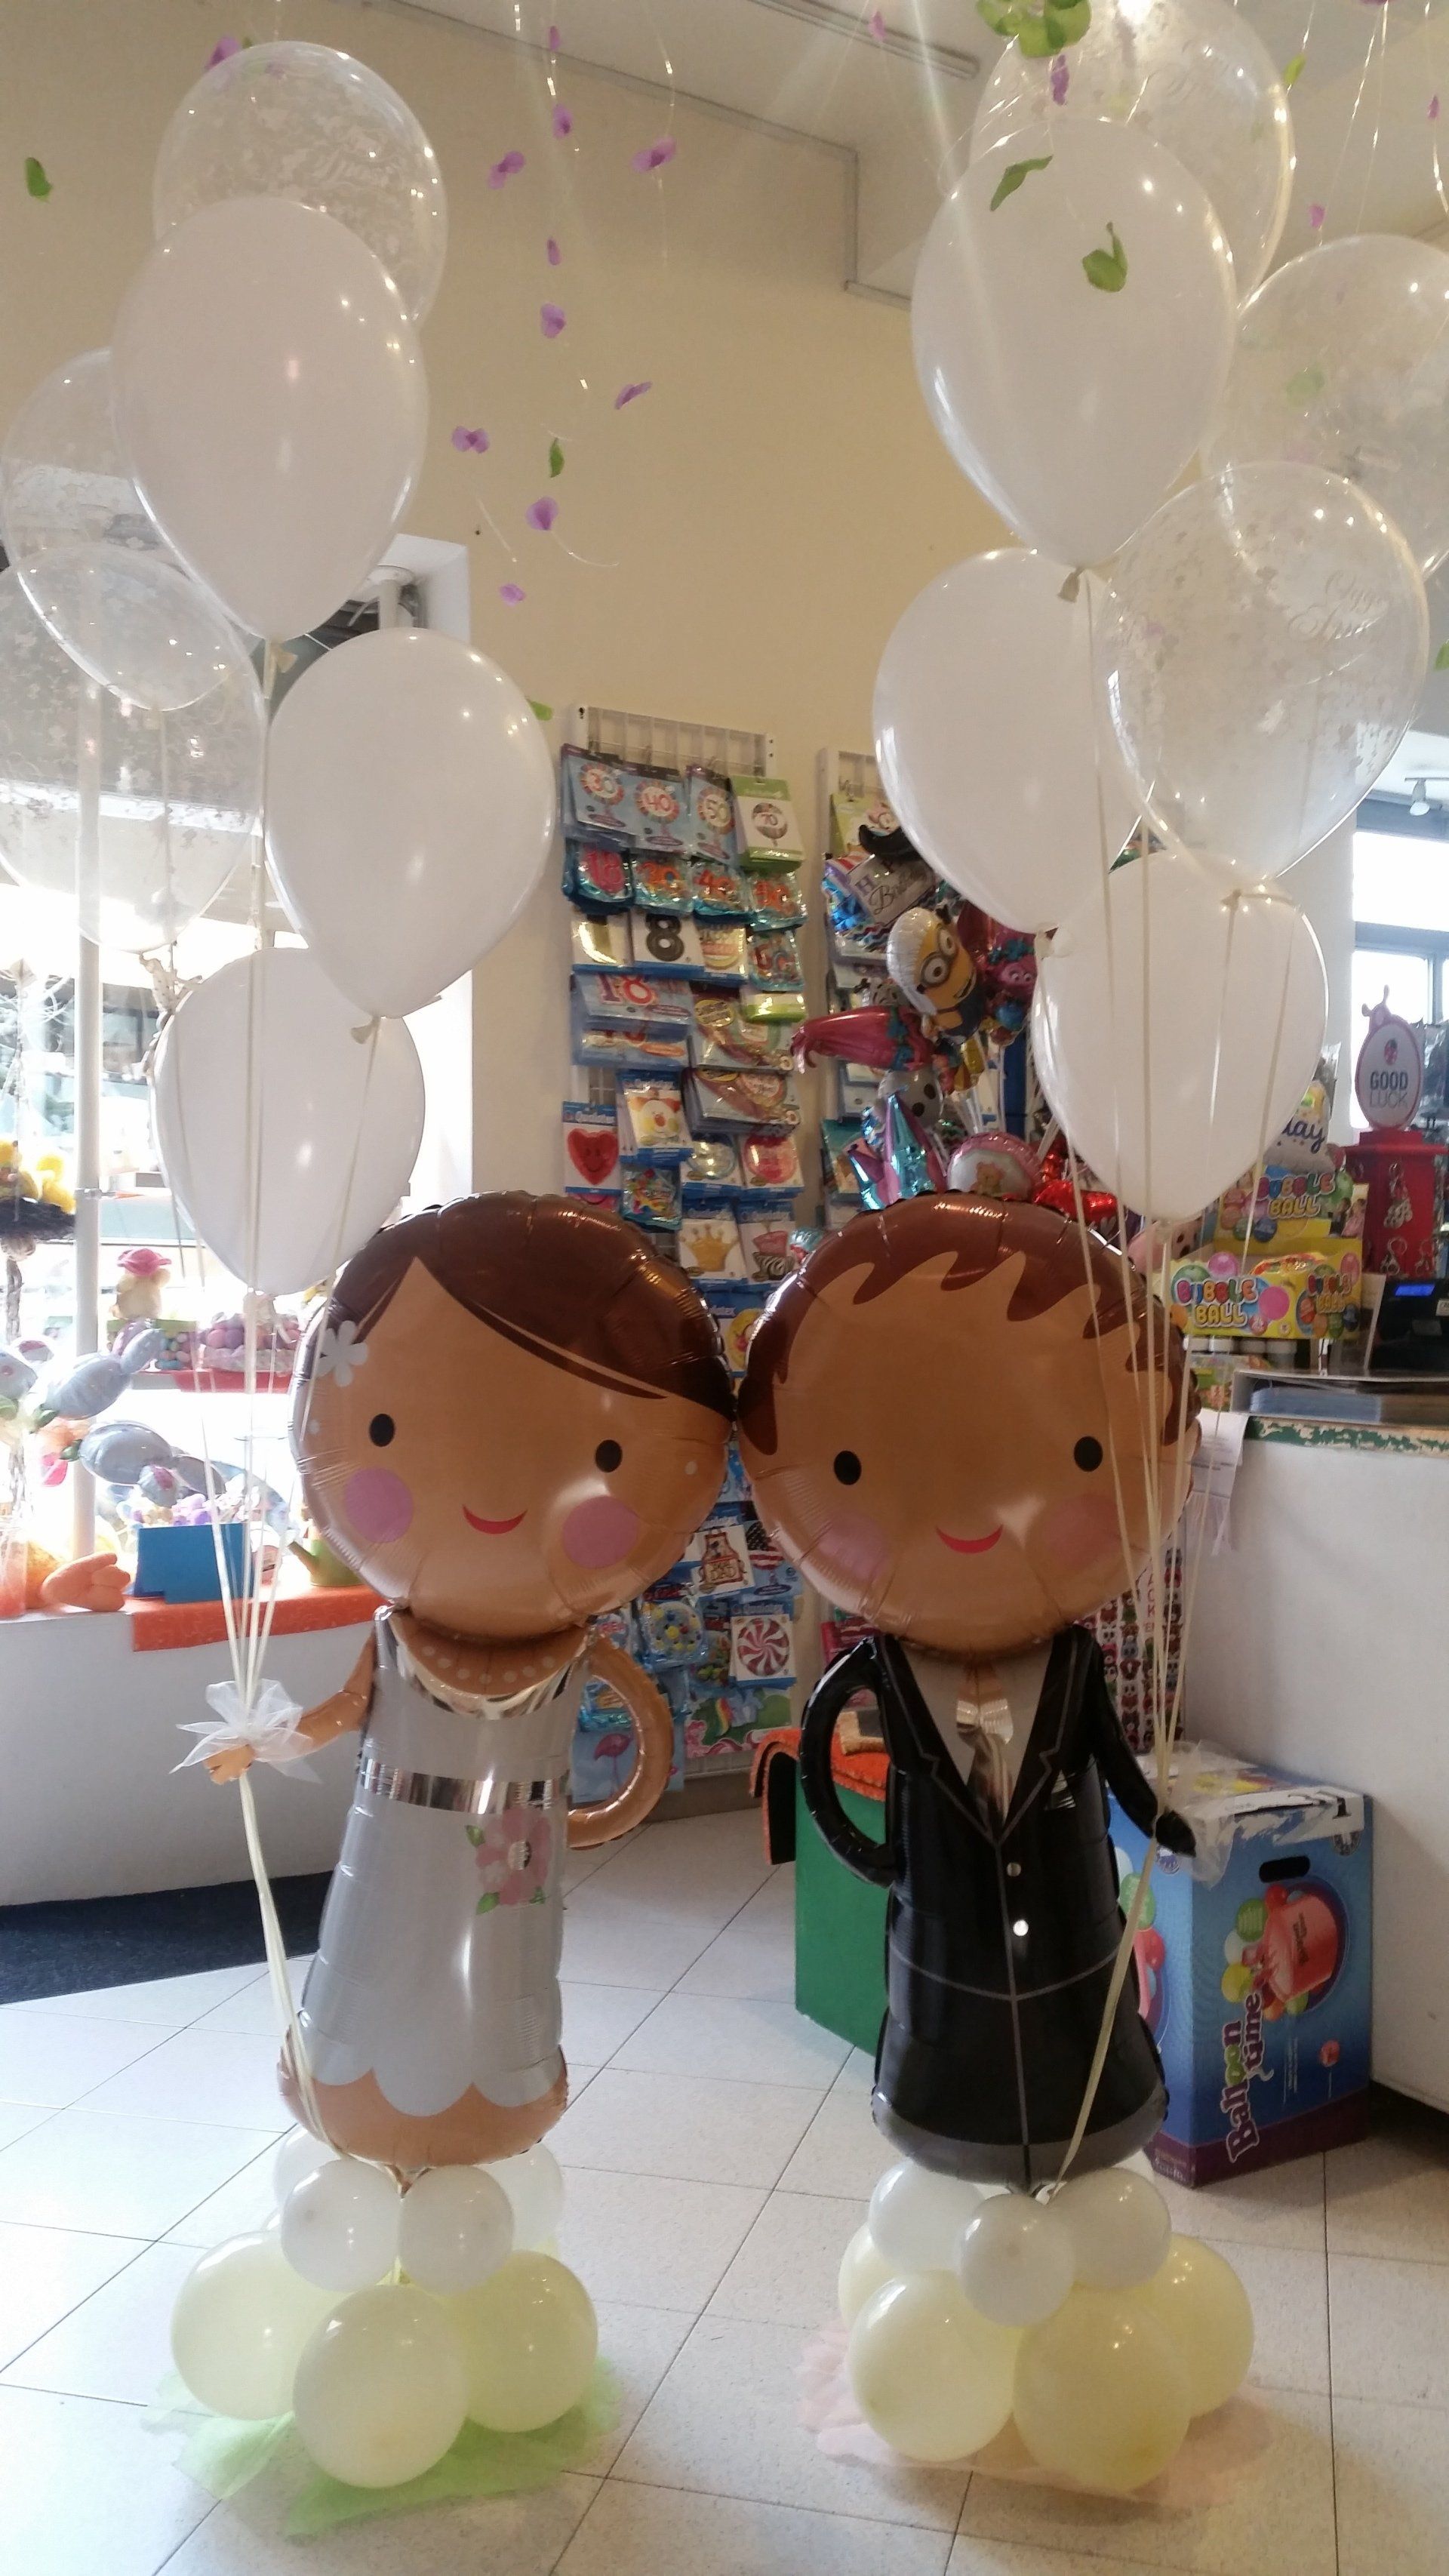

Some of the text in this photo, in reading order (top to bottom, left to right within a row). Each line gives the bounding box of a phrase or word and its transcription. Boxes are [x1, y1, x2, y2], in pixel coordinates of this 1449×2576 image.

[1370, 1071, 1408, 1091] GOOD
[1370, 1091, 1408, 1109] LUCK
[1267, 1195, 1321, 1220] BALL
[1177, 1278, 1259, 1306] BUBBLE
[1194, 1302, 1247, 1328] BALL
[1242, 1991, 1265, 2072] time
[1220, 2020, 1260, 2163] Balloon
